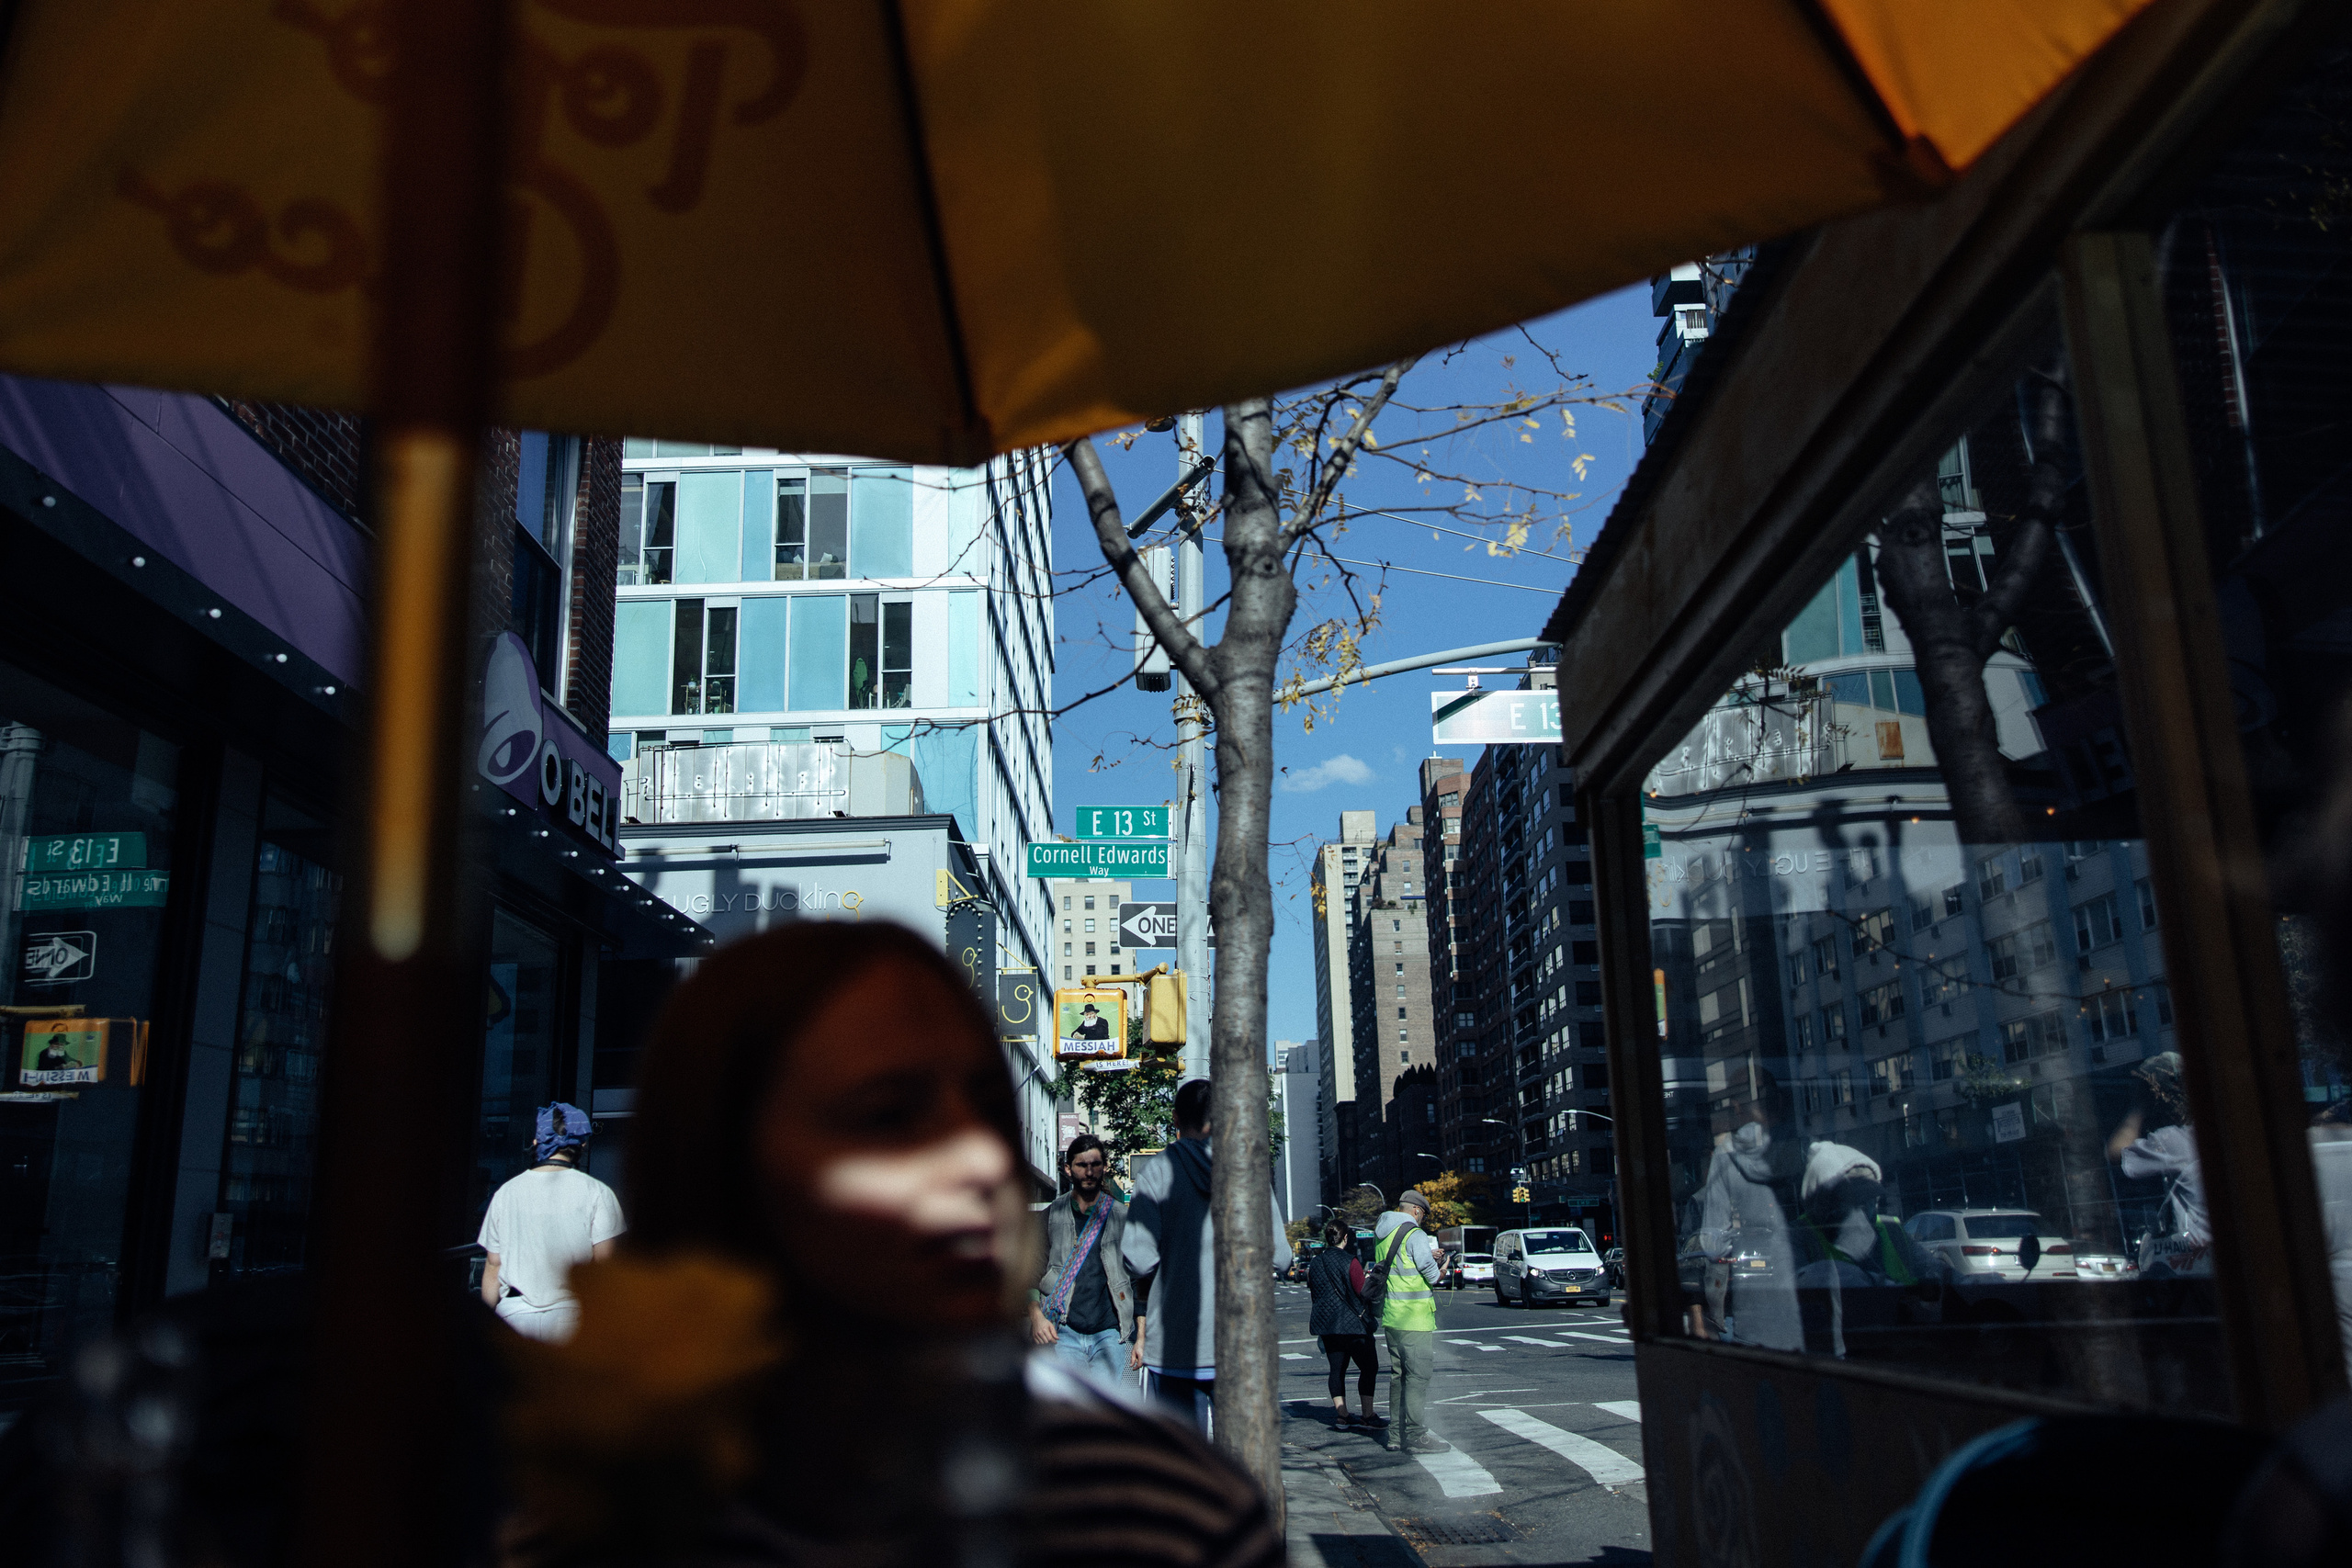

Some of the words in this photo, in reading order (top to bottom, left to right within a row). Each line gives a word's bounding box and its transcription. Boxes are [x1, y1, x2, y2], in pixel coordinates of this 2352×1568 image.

[1510, 703, 1527, 730] E
[567, 758, 626, 862] BELL
[1092, 810, 1103, 836] E
[1114, 810, 1134, 836] 13
[1143, 809, 1157, 827] St
[1033, 845, 1091, 864] Cornell
[1098, 845, 1166, 864] Edwards
[1090, 865, 1110, 877] Way
[673, 893, 739, 914] UGLY
[1137, 916, 1177, 934] ONE
[1063, 1041, 1115, 1052] MESSIAH
